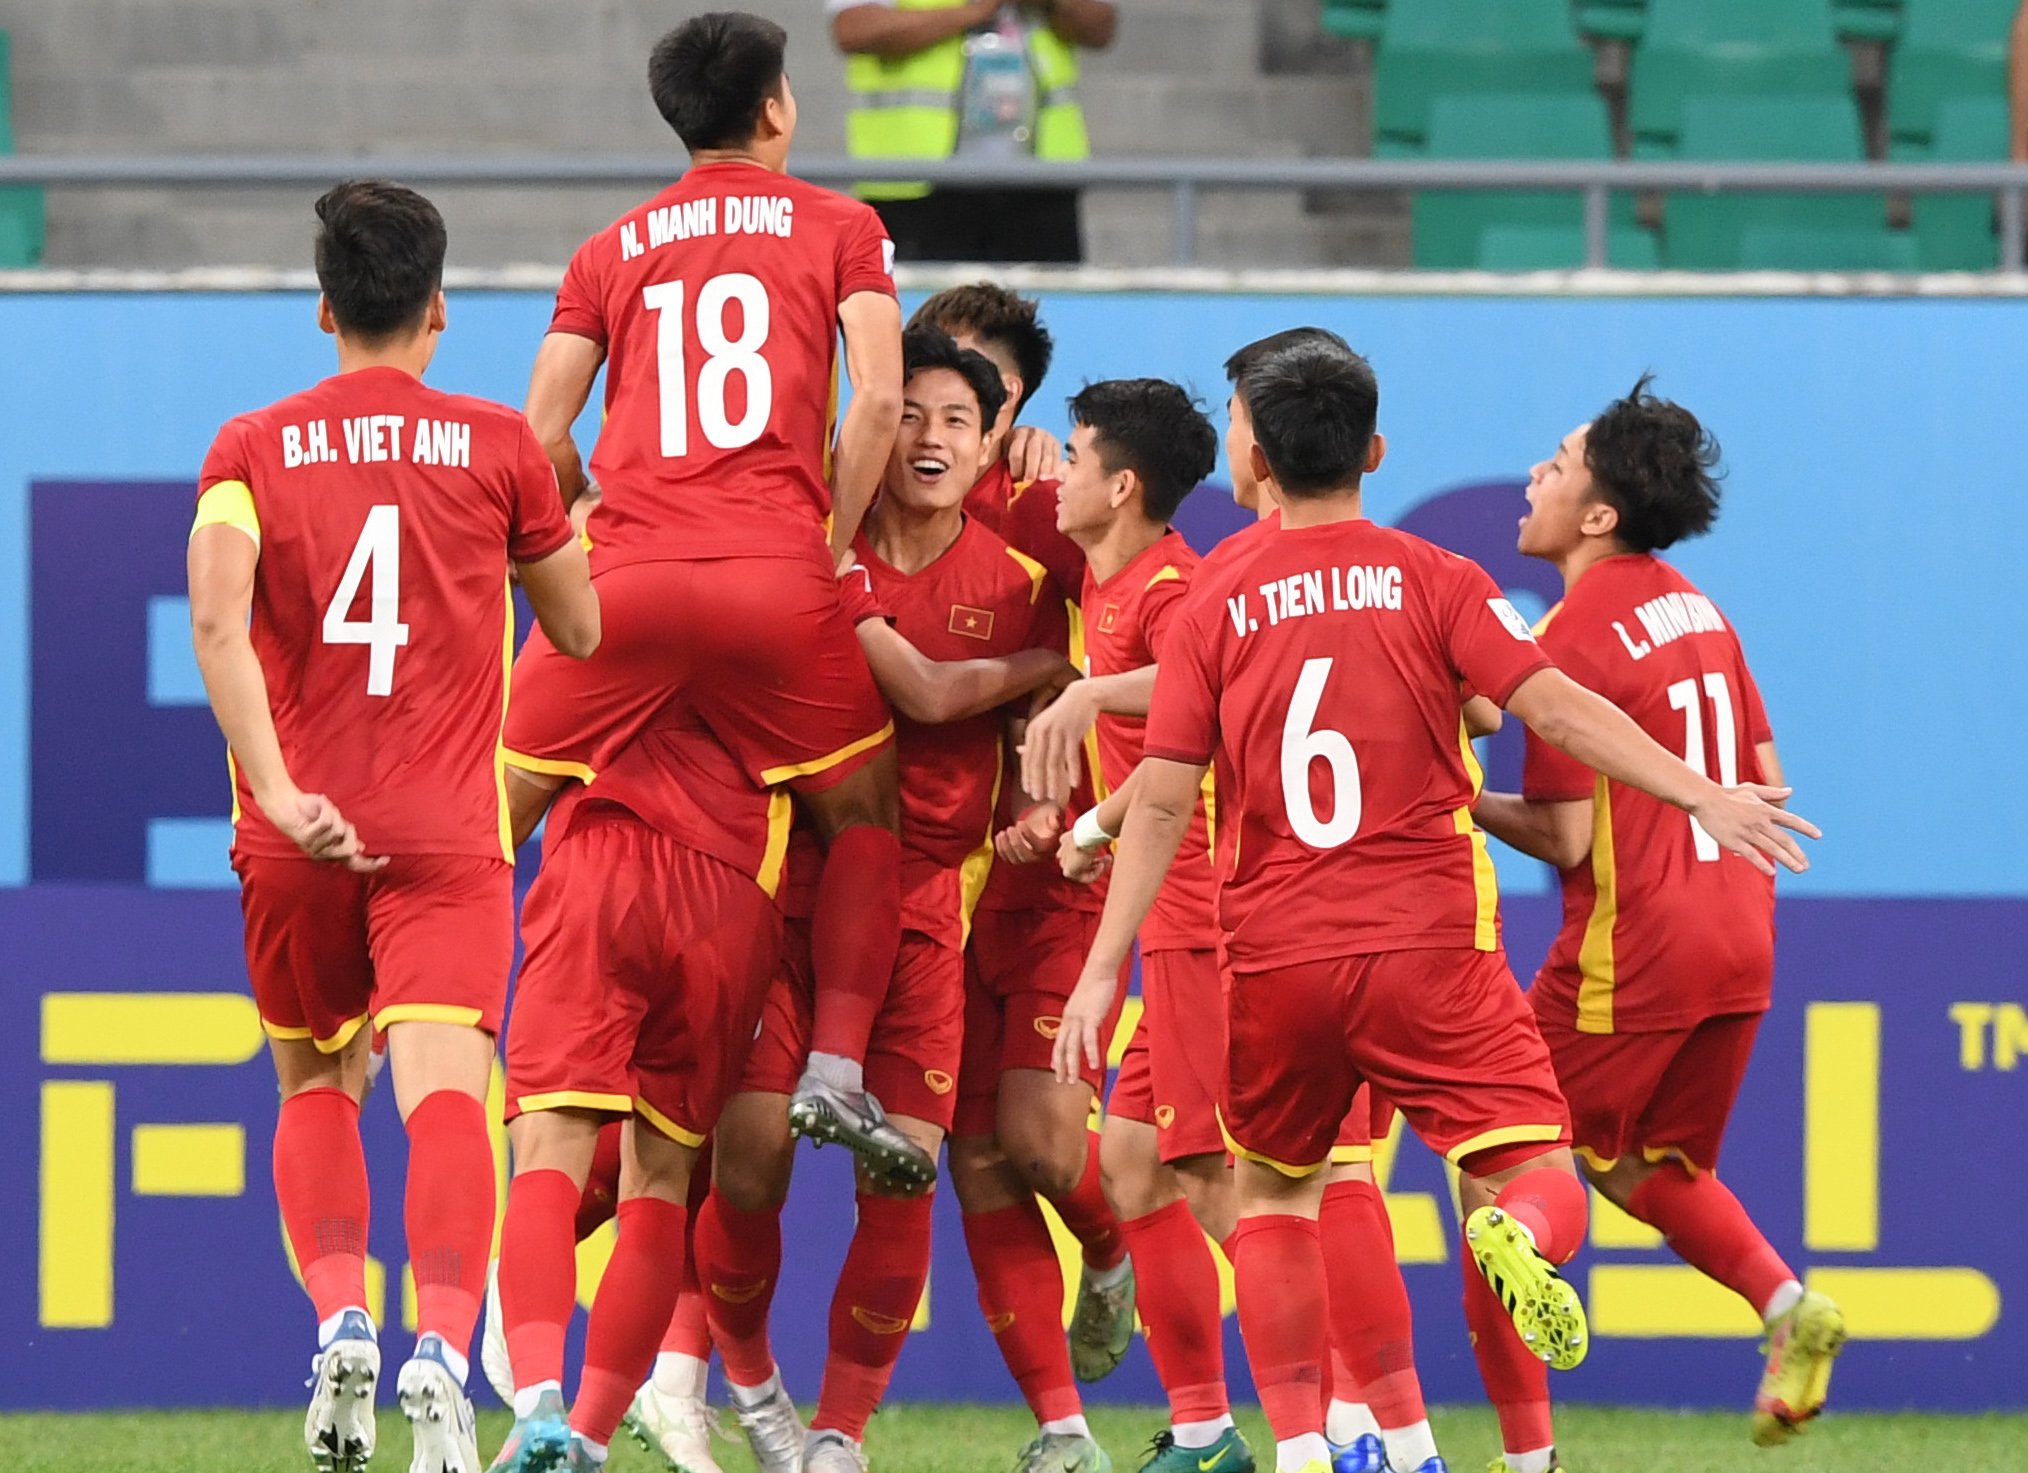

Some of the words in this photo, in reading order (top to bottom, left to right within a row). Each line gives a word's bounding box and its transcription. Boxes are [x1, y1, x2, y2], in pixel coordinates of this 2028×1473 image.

[620, 220, 645, 262] N.
[647, 197, 717, 250] MANH
[724, 195, 794, 238] DUNG
[642, 272, 772, 458] 18
[281, 419, 338, 469] B.H.
[342, 414, 405, 464] VIET
[412, 418, 471, 468] ANH
[322, 504, 410, 697] 4
[1226, 593, 1259, 638] V.
[1259, 569, 1325, 626] TIEN
[1331, 565, 1403, 611] LONG
[1611, 620, 1652, 661] L.
[1280, 657, 1362, 849] 6
[1668, 672, 1738, 862] 11
